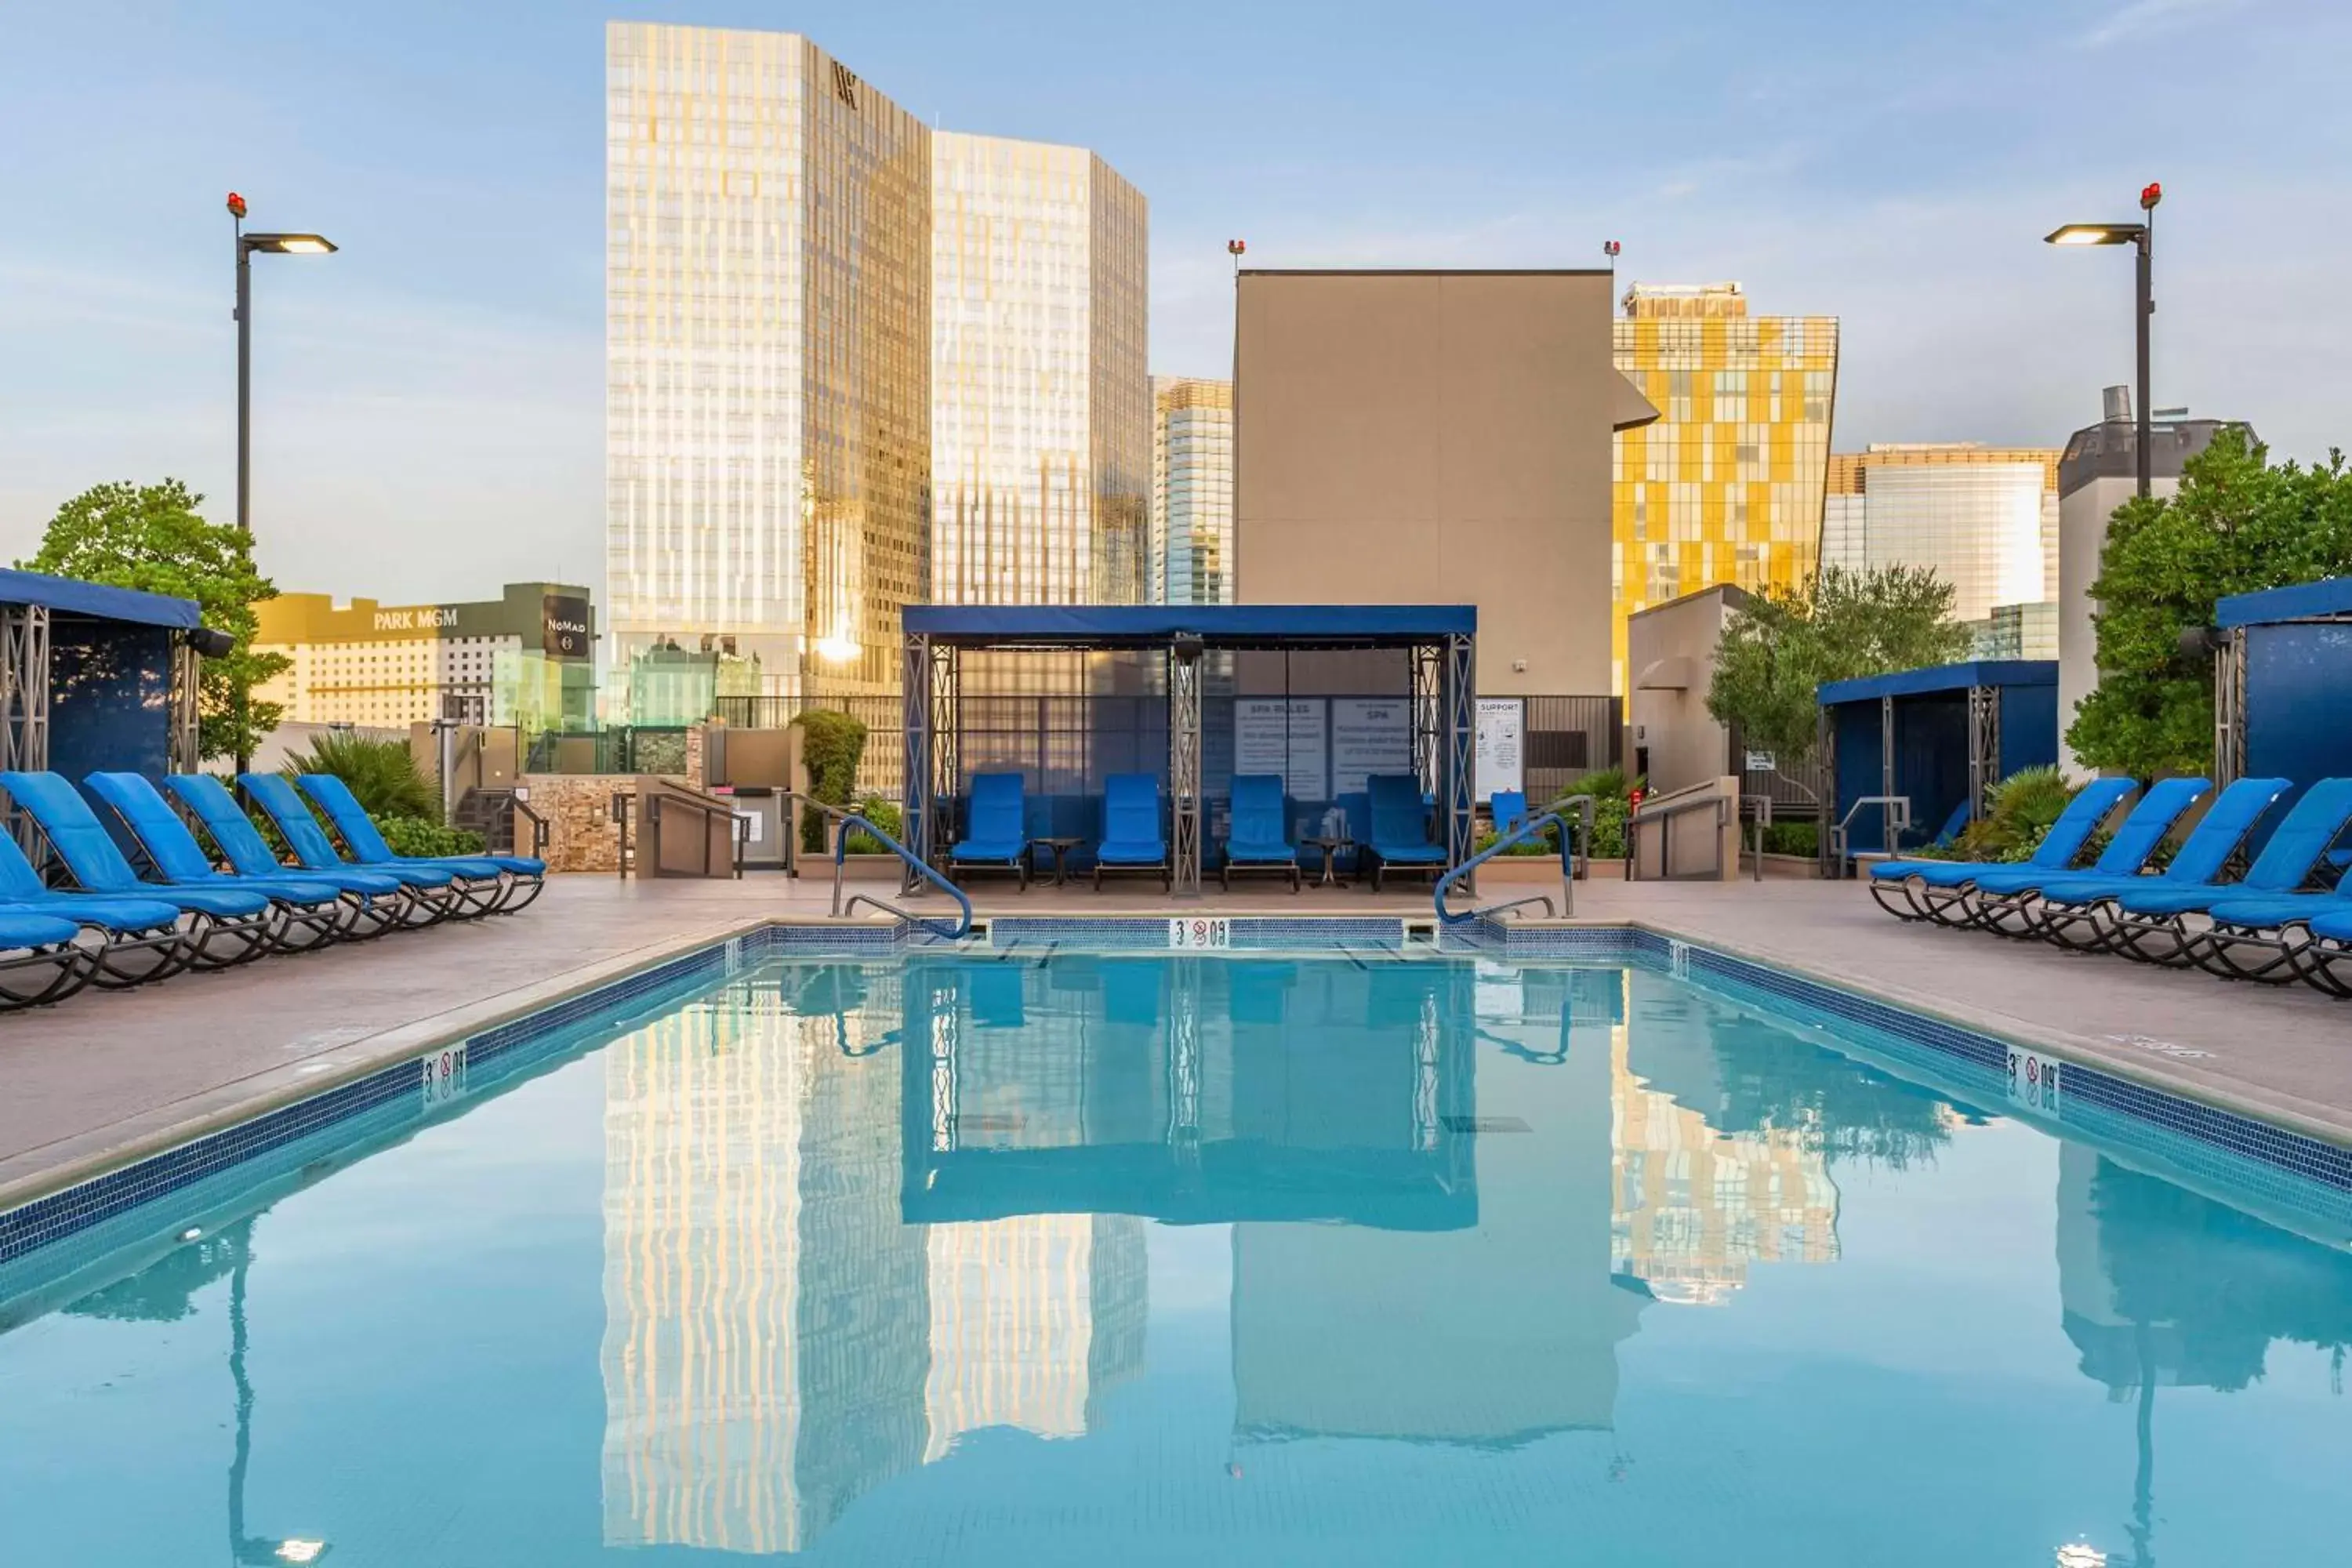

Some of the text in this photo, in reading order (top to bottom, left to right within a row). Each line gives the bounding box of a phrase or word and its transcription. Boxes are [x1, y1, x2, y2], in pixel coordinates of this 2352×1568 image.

[374, 608, 458, 630] PARK MGM
[1250, 704, 1310, 713] SPA RULES
[1480, 702, 1519, 711] SUPPORT
[1367, 710, 1389, 720] SPA
